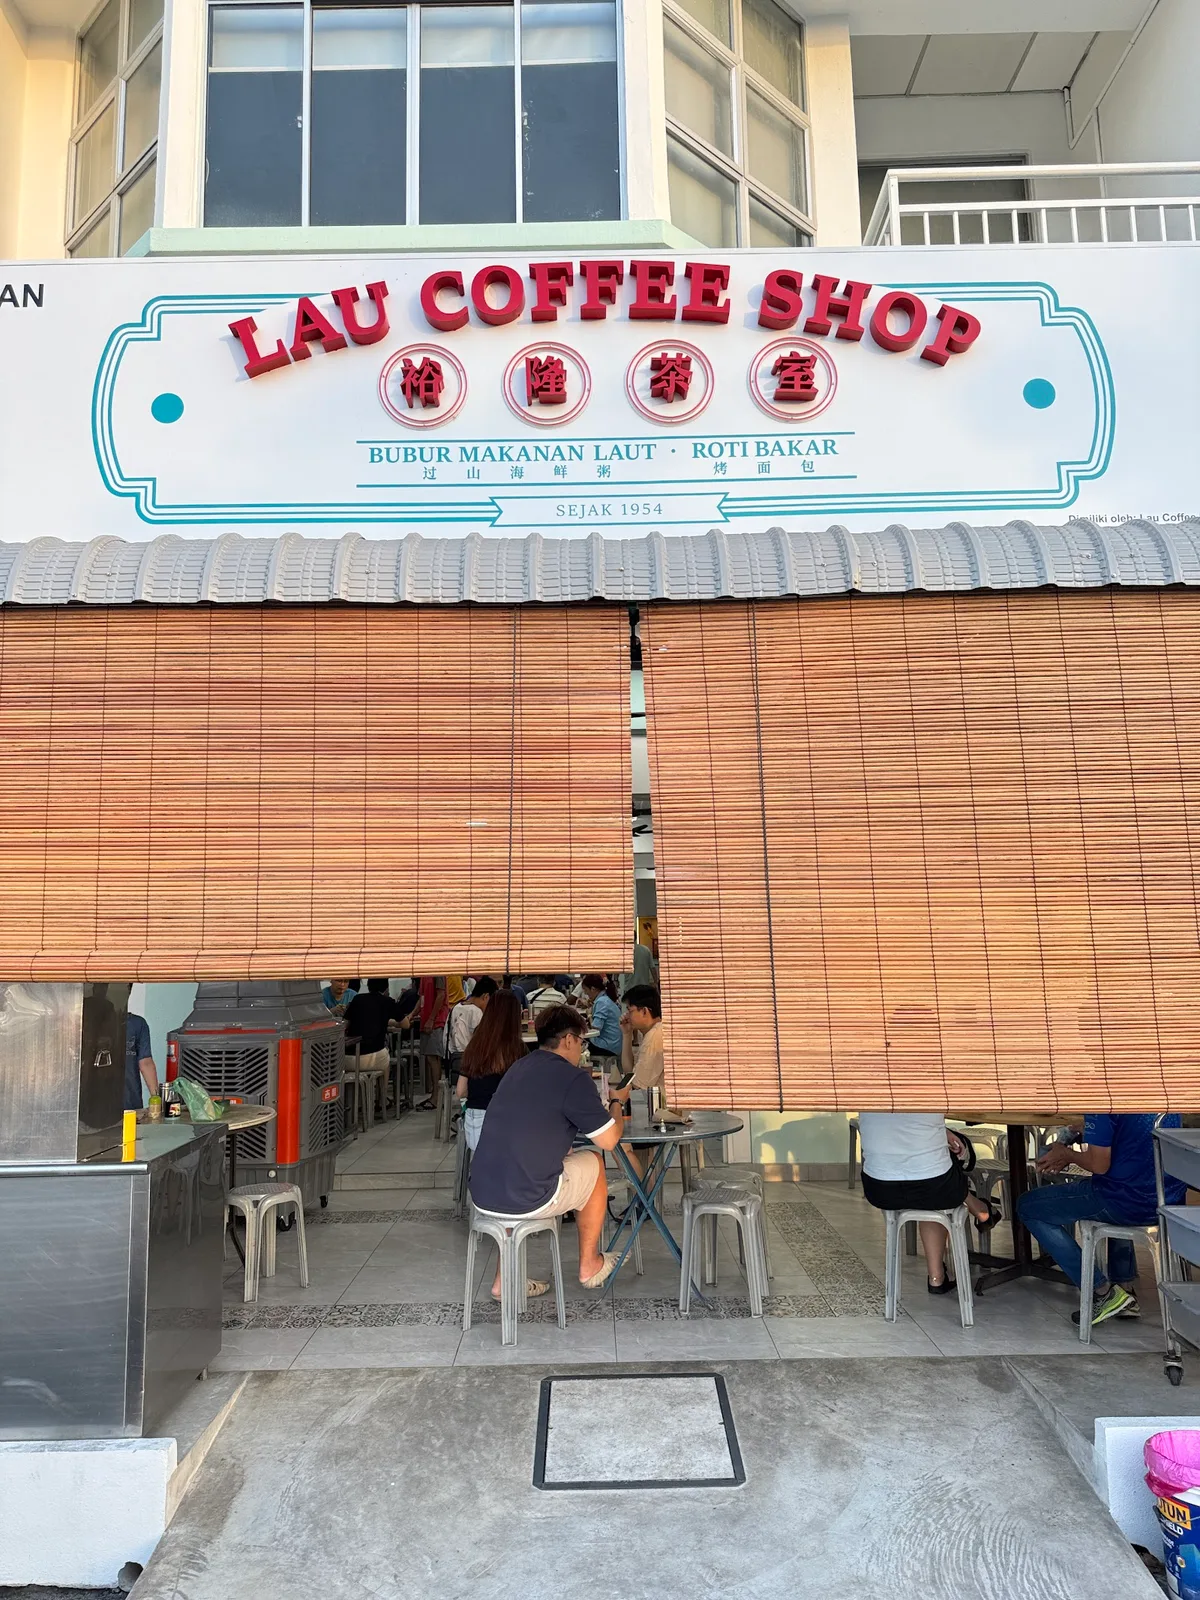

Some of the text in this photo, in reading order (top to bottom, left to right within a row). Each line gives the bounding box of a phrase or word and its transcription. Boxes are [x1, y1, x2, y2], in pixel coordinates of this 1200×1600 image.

[0, 283, 44, 308] AN
[228, 260, 981, 379] LAU COFFEE SHOP
[400, 351, 819, 408] 裕隆茶室
[369, 439, 839, 464] BUBUR MAKANAN LAUT ROTI BAKAR
[423, 464, 612, 480] 过山海鲜粥
[713, 459, 816, 476] 烤面包
[556, 502, 663, 518] SEJAK 1954
[1159, 1498, 1188, 1525] TUN
